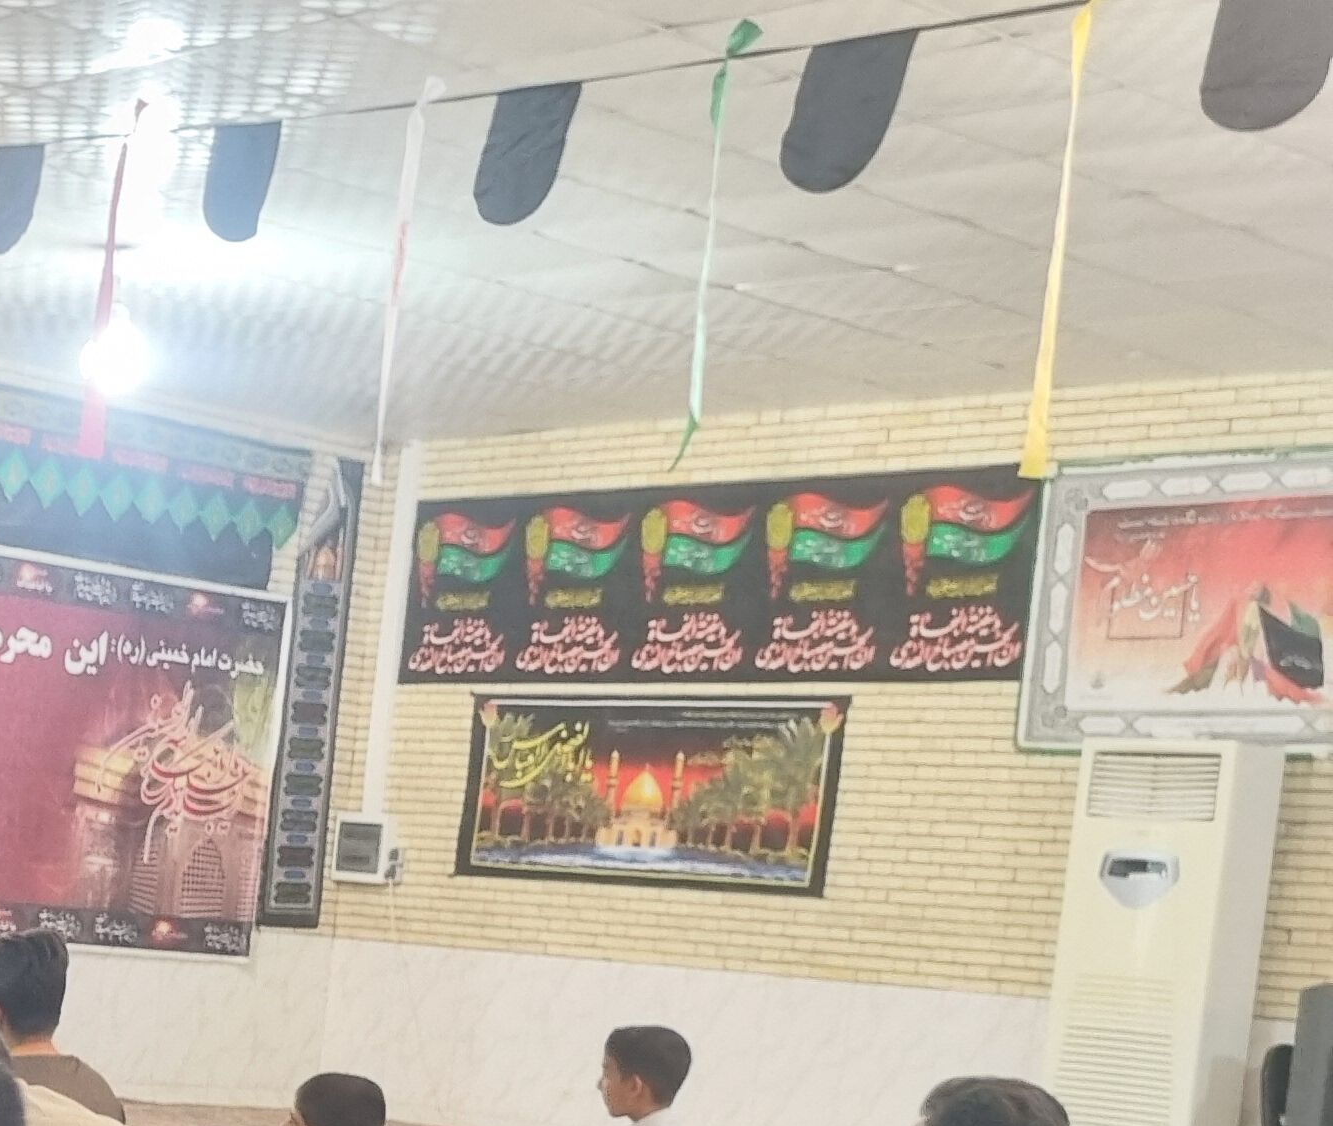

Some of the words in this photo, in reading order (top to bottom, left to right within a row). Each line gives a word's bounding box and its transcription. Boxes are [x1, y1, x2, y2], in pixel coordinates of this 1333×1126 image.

[64, 630, 109, 676] این
[146, 640, 190, 669] خمینی
[191, 645, 217, 673] امام
[218, 653, 265, 679] حضرت
